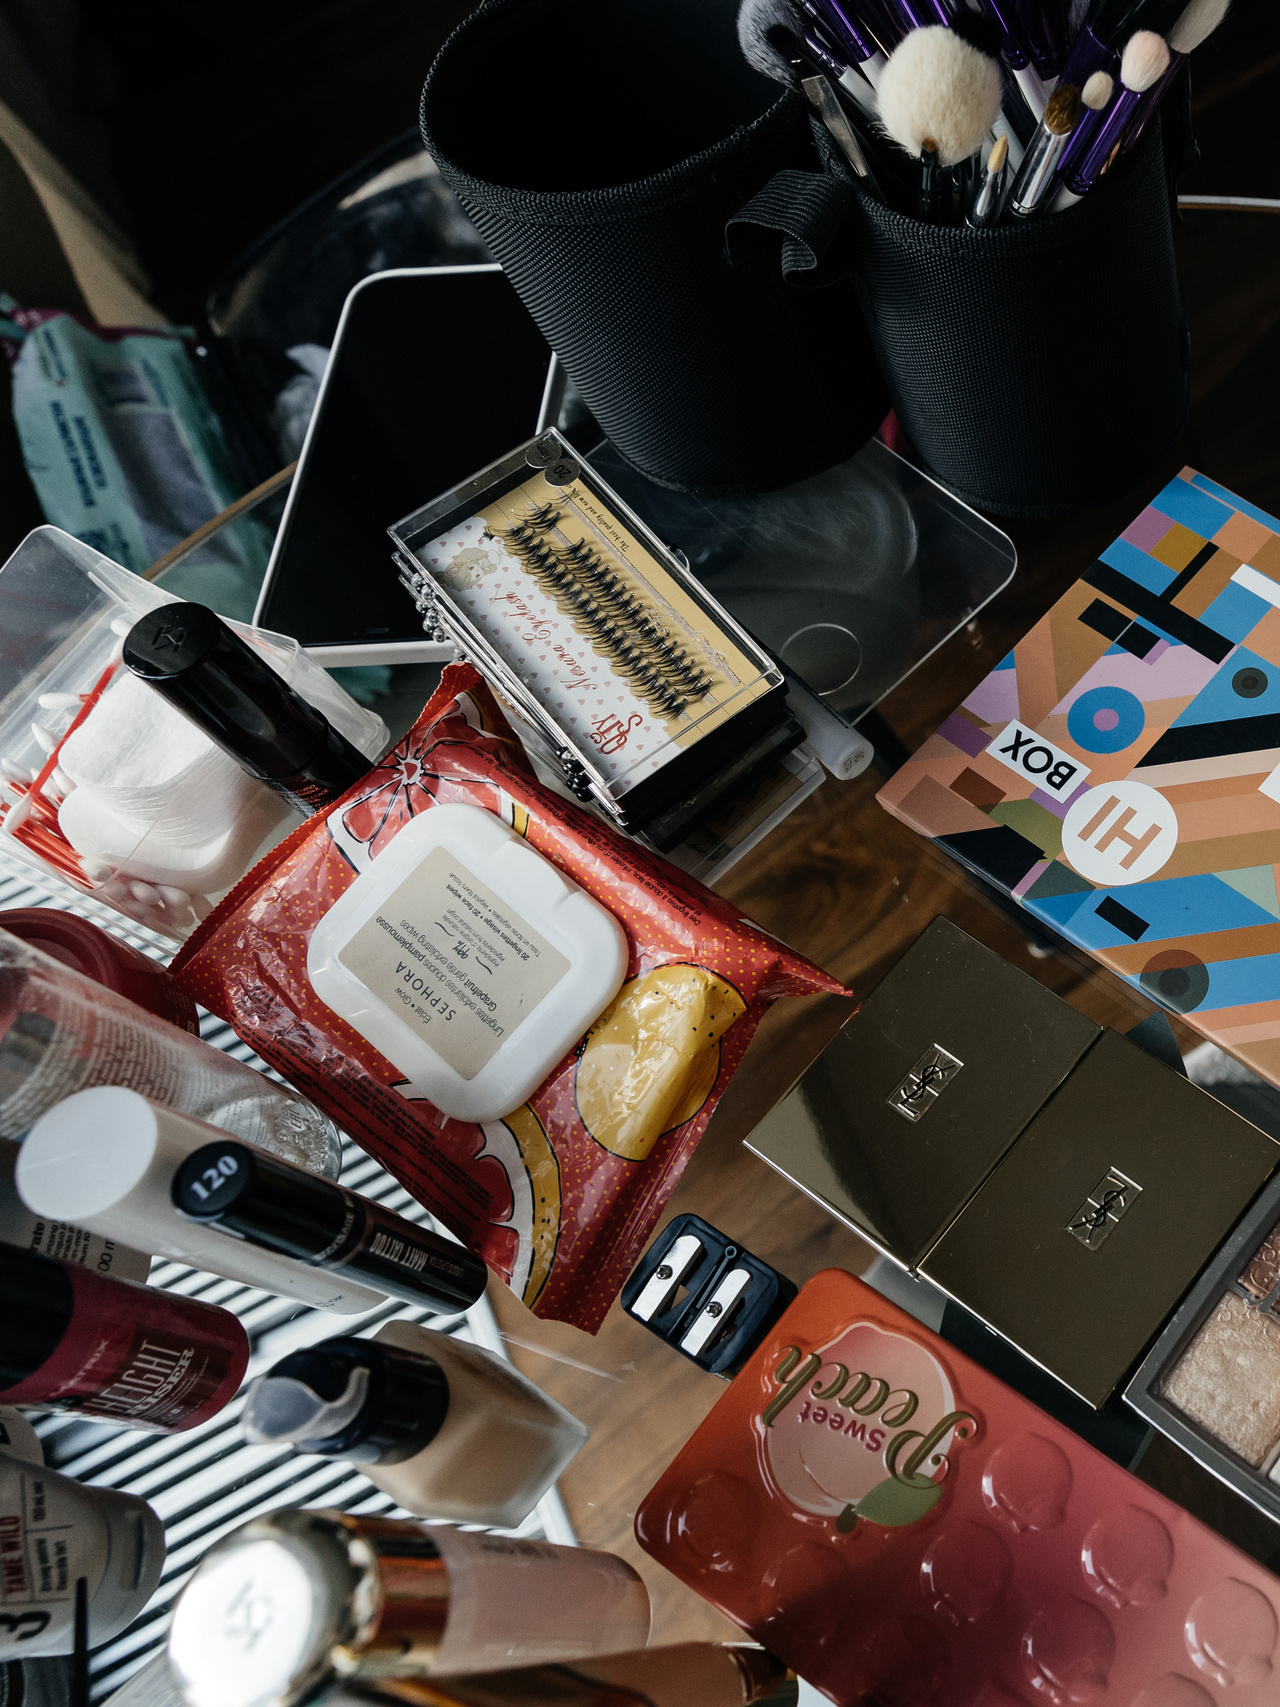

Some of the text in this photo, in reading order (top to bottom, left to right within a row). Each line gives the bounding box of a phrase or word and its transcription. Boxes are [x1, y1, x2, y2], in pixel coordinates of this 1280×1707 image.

[552, 462, 571, 481] 20
[585, 504, 597, 516] and
[594, 512, 613, 532] quality
[487, 578, 559, 651] Eyelash
[1000, 728, 1079, 788] BOX
[1080, 794, 1164, 871] HI
[445, 882, 530, 961] 20 lingettes visage 20 face wipes
[374, 913, 505, 1037] Lingettes exfoliantes douces pamplemousse
[392, 960, 456, 1021] SEPHORA
[393, 986, 412, 1005] Glow
[398, 917, 499, 1012] Grapefruit gentle exfoliating wipes
[189, 1152, 242, 1203] 120
[368, 1231, 429, 1272] MATT TATTOO
[82, 1339, 181, 1412] HEIGHT
[124, 1346, 195, 1415] RISER
[762, 1343, 980, 1483] Peach
[802, 1397, 887, 1455] Sweet
[0, 1516, 26, 1592] TAME WILD
